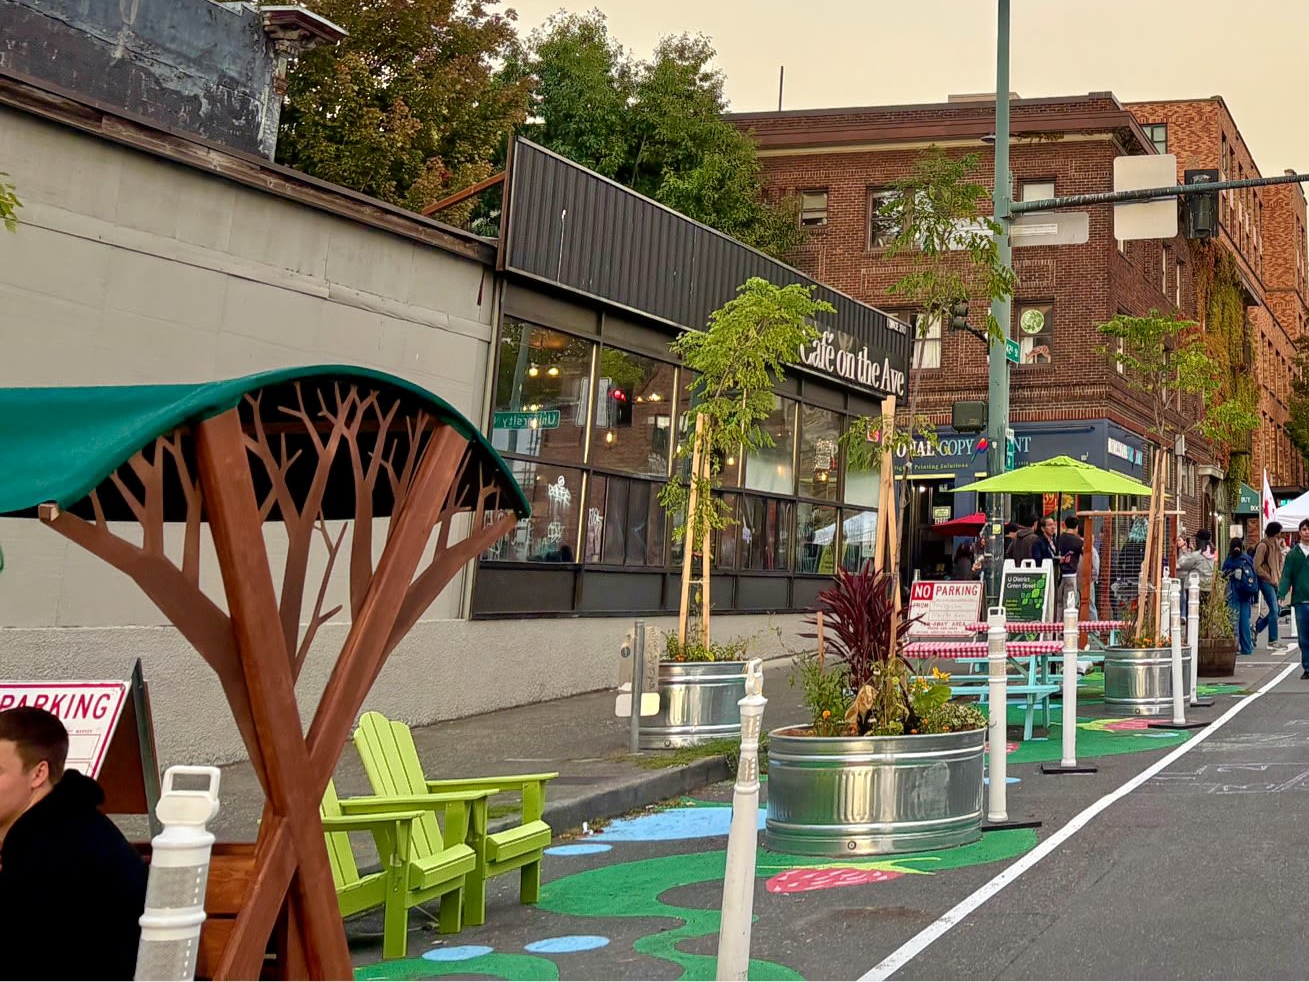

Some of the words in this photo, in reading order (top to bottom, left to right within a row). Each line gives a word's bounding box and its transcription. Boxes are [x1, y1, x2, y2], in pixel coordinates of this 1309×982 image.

[800, 330, 835, 372] Café
[836, 349, 856, 380] on
[857, 346, 880, 388] the
[880, 357, 905, 396] Ave
[939, 438, 975, 456] COPY
[914, 584, 931, 599] NO
[935, 585, 978, 597] PARKING
